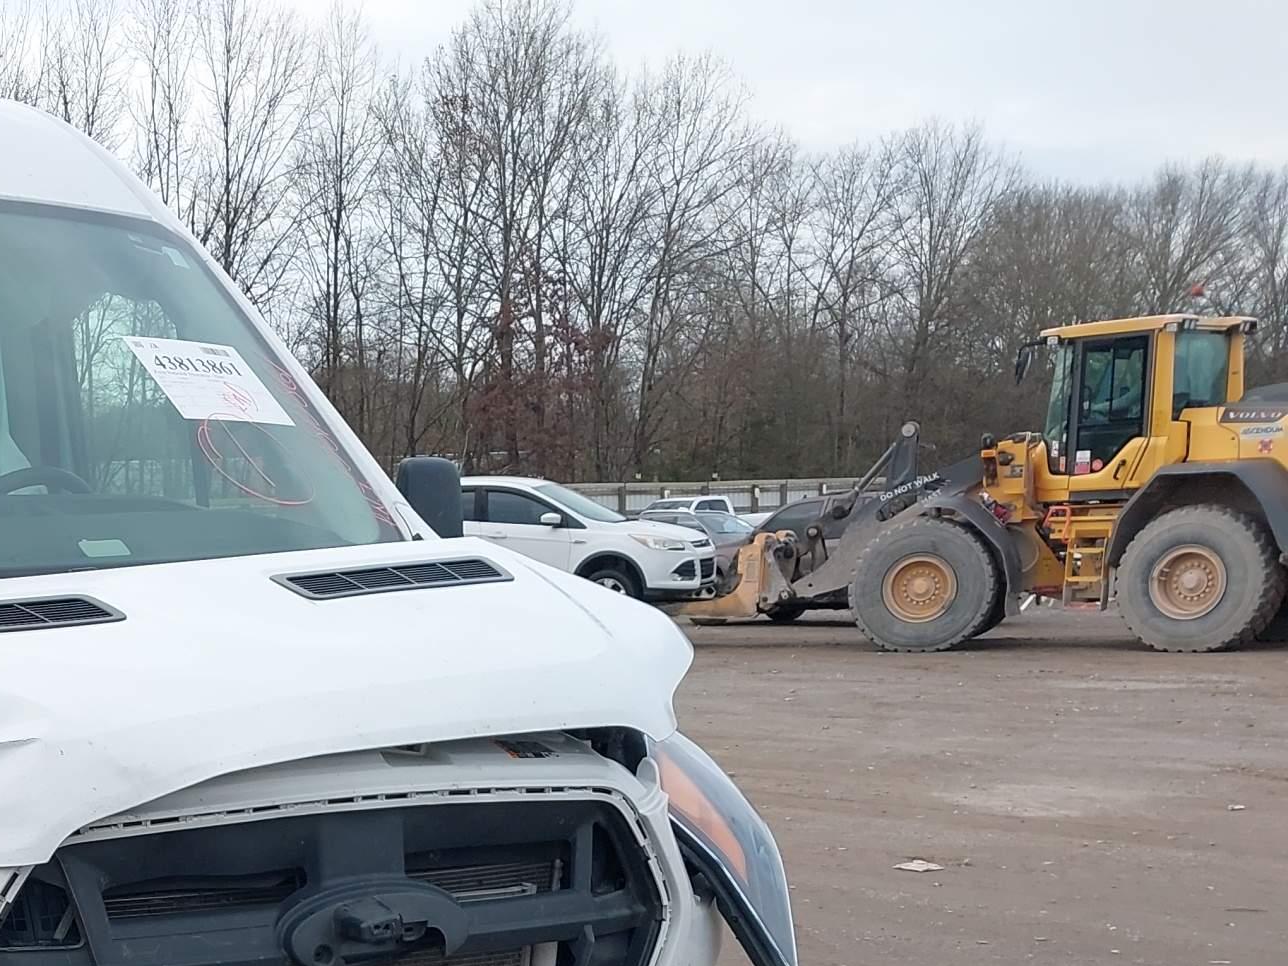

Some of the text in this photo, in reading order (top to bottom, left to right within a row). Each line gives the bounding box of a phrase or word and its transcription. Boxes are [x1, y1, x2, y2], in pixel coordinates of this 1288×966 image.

[153, 354, 242, 377] 43813861
[1229, 411, 1282, 419] VOLVO
[880, 472, 941, 502] DO NOT WALK
